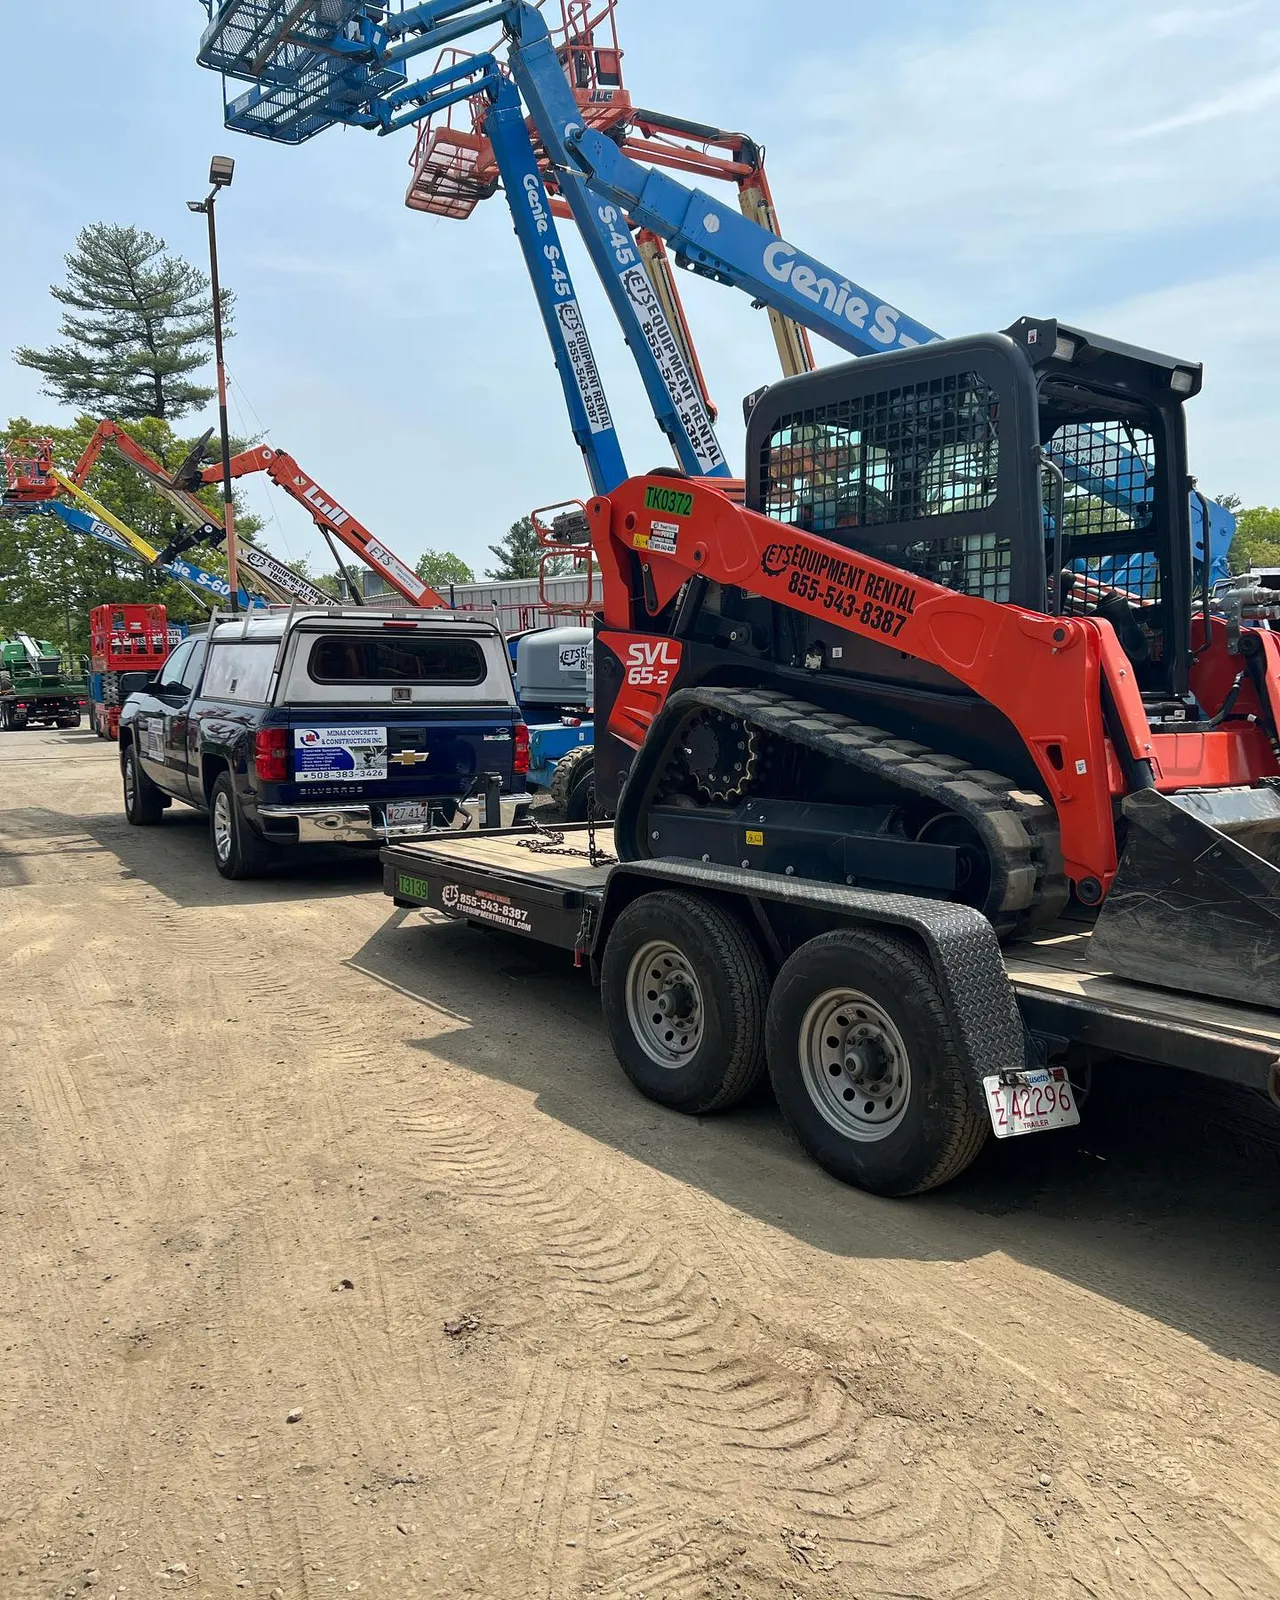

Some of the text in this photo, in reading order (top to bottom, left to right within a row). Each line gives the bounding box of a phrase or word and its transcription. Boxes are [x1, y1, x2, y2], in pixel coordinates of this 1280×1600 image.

[588, 90, 614, 103] JLG
[523, 173, 572, 297] Genie S-45
[598, 205, 635, 265] S-45
[763, 241, 946, 348] Genie S-
[565, 308, 612, 429] ETS EQUIPMENT RENTAL
[567, 340, 600, 424] 855-543-8387
[631, 276, 721, 466] ETS EQUIPMENT RENTAL
[641, 321, 707, 459] 855-543-8387
[303, 485, 350, 527] Lull
[646, 486, 692, 516] TK0372
[93, 522, 114, 537] ETS
[370, 546, 394, 566] ETS
[163, 559, 231, 596] nie S-60
[251, 553, 336, 606] ETS EQUIPMENT RETA
[767, 543, 917, 614] ETS EQUIPMENT RENTAL
[788, 571, 907, 637] 855-543-8387
[564, 648, 580, 660] ETS
[626, 642, 678, 665] SVL
[628, 667, 669, 685] 65-2
[310, 770, 384, 780] 508-383-3426
[400, 875, 427, 898] T3139
[445, 885, 459, 899] ETS
[459, 893, 529, 921] 855-543-8387
[456, 903, 532, 932] ETSEQUIPMENTRENTAL.COM
[1011, 1083, 1071, 1120] 42296
[1023, 1119, 1050, 1129] TRAILER
